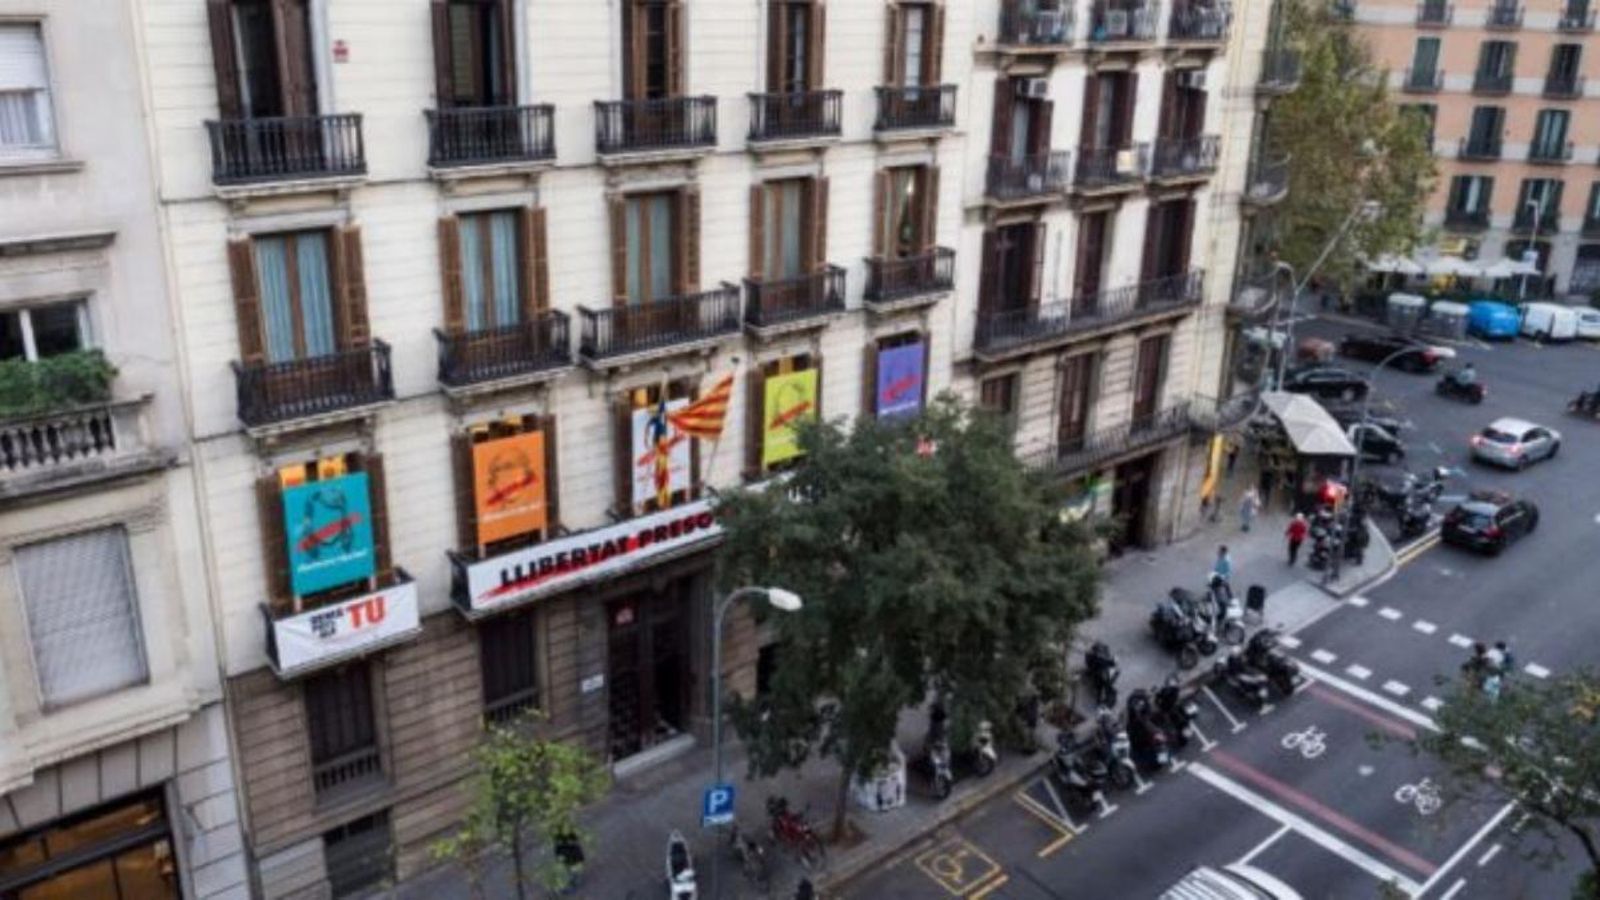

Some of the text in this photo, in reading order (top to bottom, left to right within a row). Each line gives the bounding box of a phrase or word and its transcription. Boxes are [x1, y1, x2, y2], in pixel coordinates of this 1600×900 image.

[501, 512, 714, 585] LLIBERTAT PRESO
[347, 597, 385, 629] TU
[710, 790, 727, 813] P
